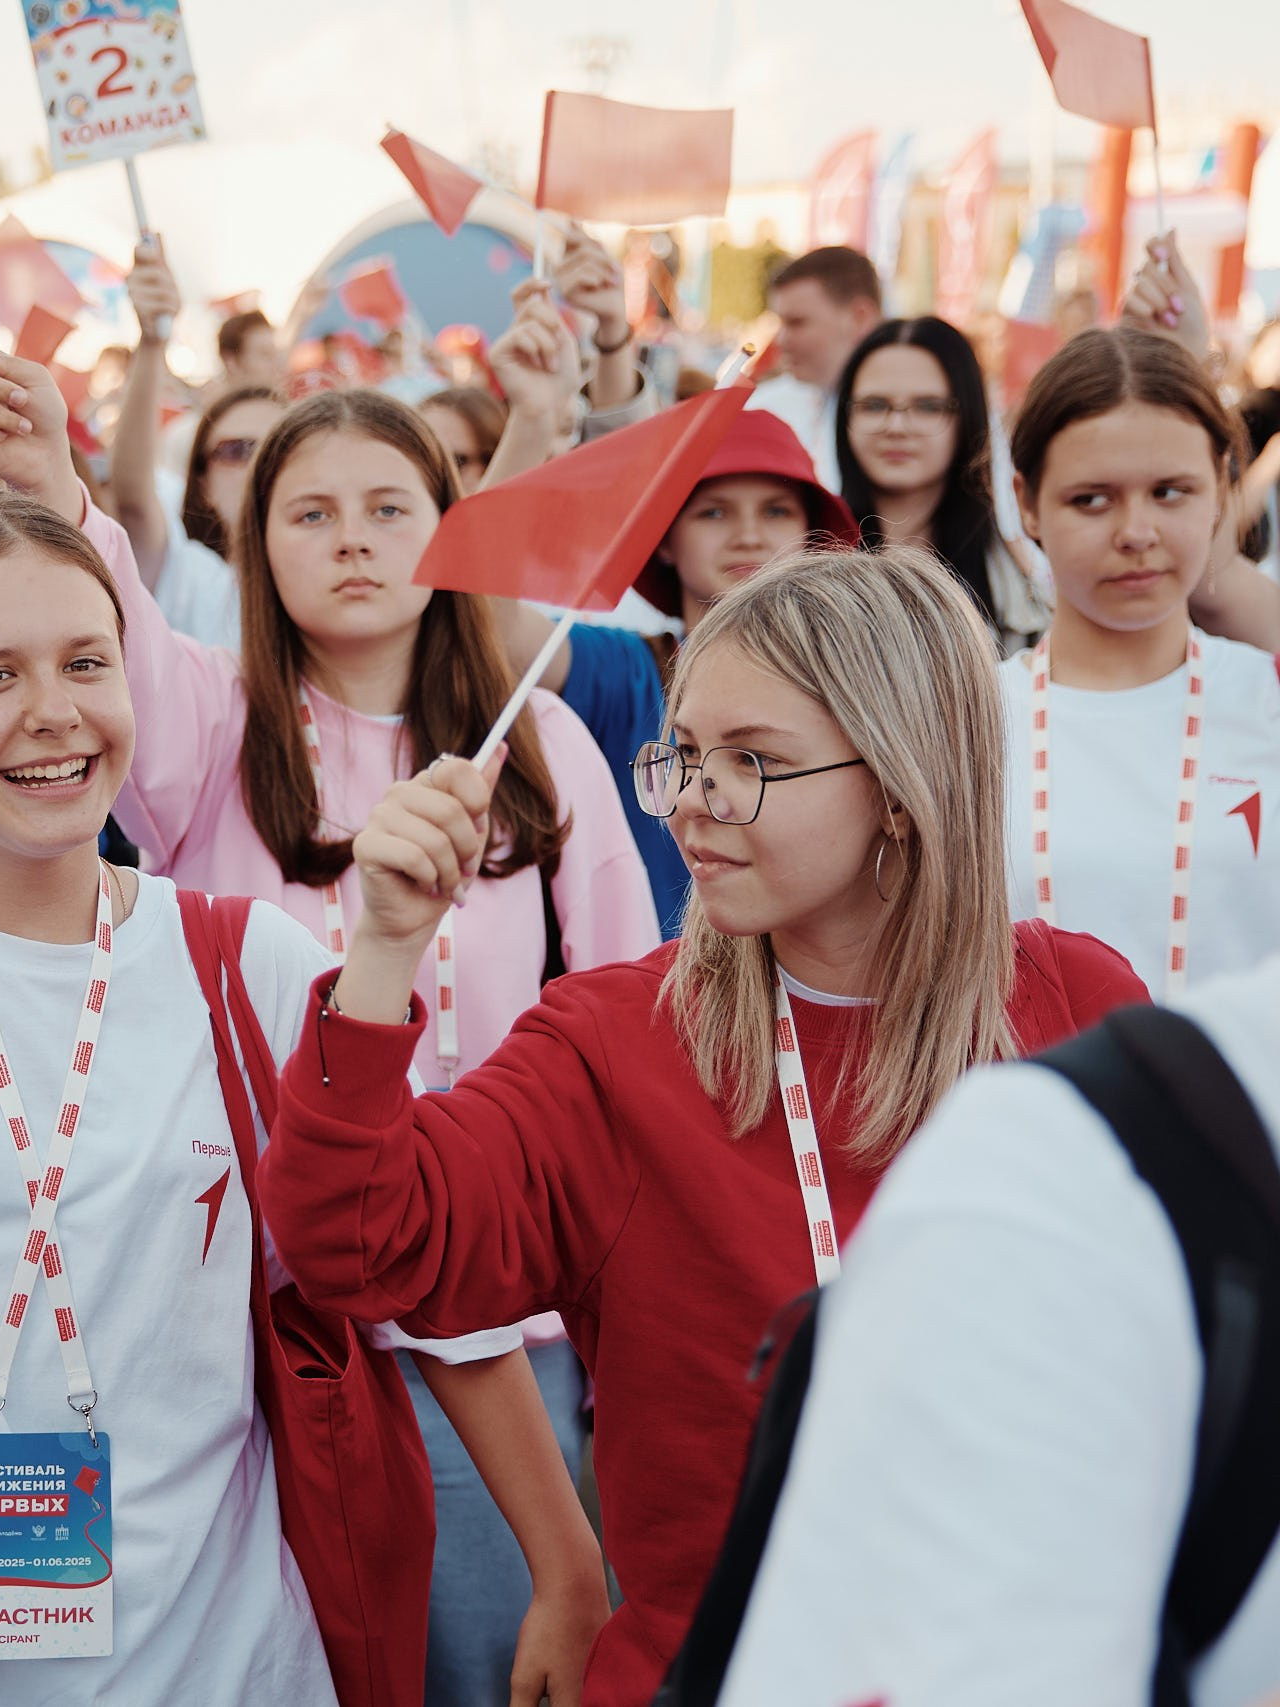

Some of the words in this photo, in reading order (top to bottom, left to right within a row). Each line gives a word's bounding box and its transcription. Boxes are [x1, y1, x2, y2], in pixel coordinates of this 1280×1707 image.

[90, 47, 133, 98] 2
[60, 104, 191, 146] КОМАНДА
[192, 1140, 231, 1158] Первые
